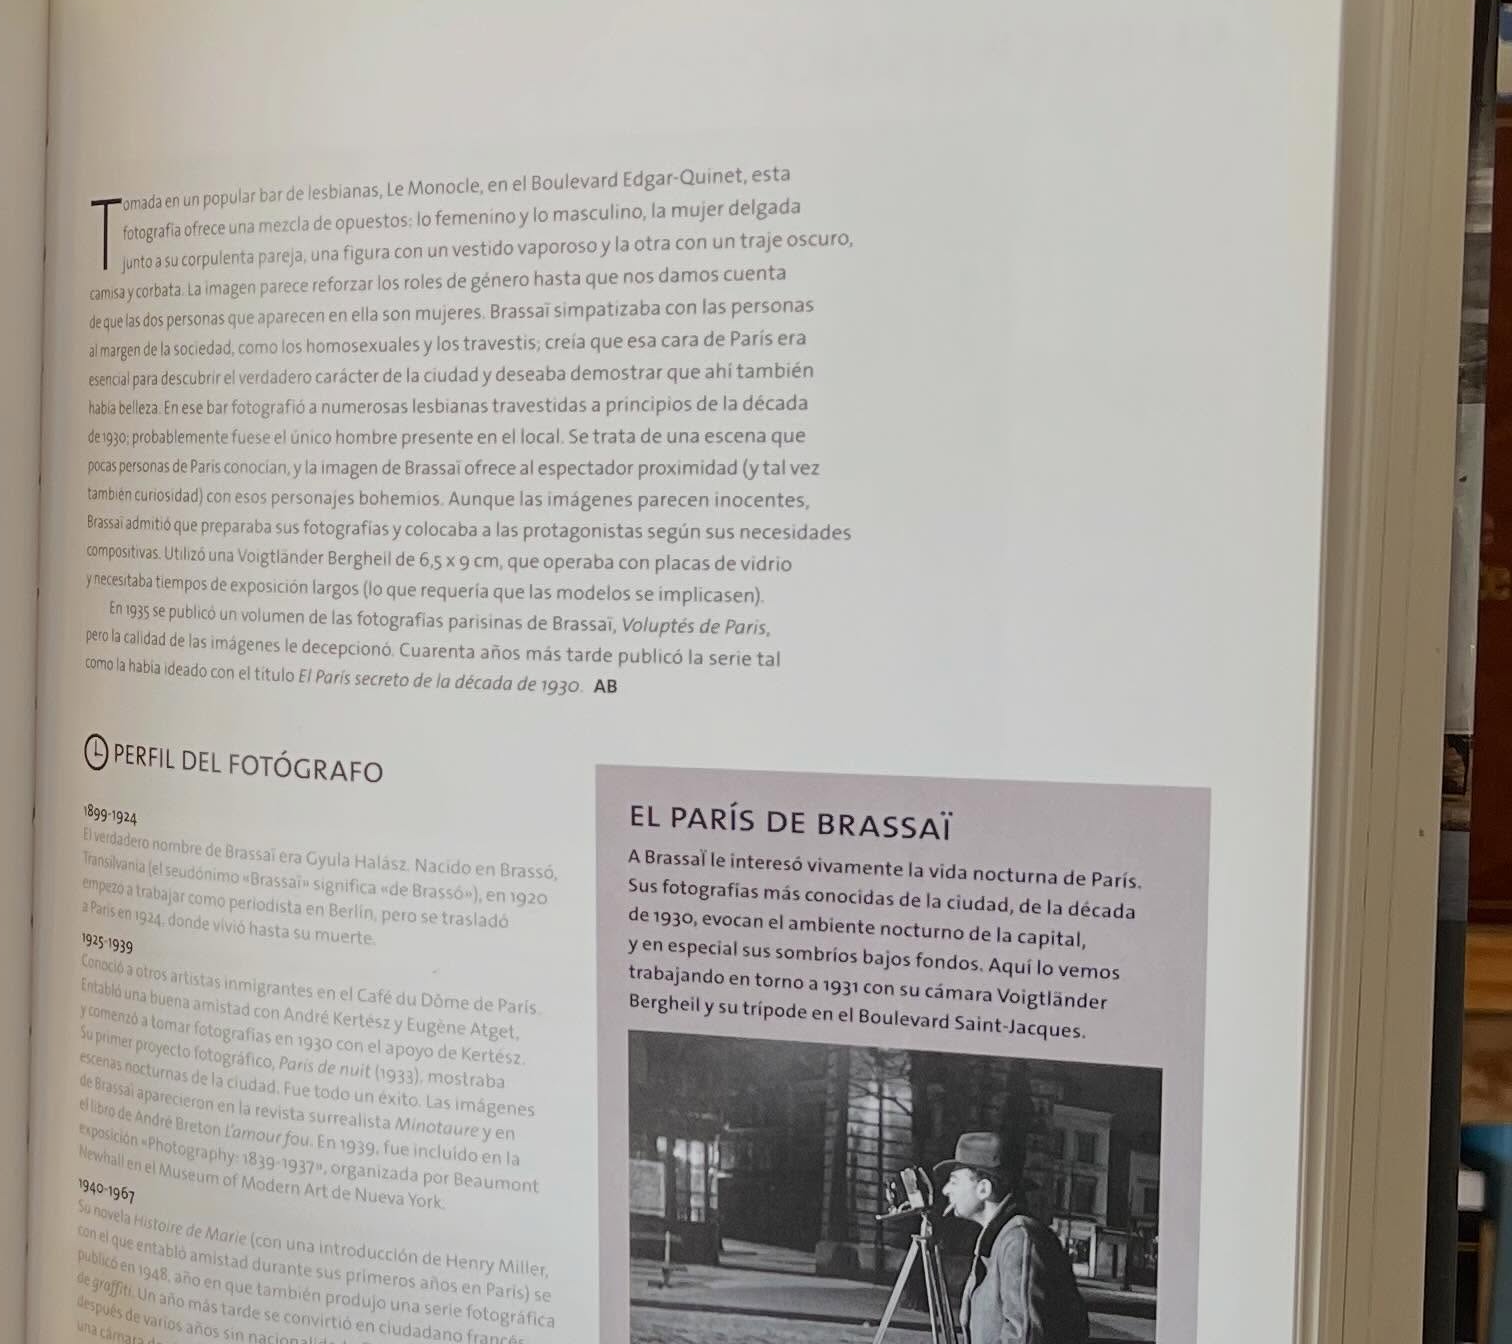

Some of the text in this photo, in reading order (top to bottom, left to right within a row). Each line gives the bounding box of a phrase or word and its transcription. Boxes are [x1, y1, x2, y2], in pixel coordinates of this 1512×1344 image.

[122, 196, 801, 246] fotografía ofrece una mezcla de opuestos: lo femenino y lo masculino, la mujer delgada
[541, 678, 619, 696] 1930. AB
[113, 741, 384, 784] PERFIL DEL FOTÓGRAFO
[83, 803, 138, 828] 1899-1924
[630, 801, 954, 841] EL PARÍS DE BRASSAÏ
[627, 848, 641, 864] A
[710, 851, 726, 868] le
[730, 852, 803, 872] interesó
[806, 857, 904, 877] vivamente
[908, 861, 924, 879] la
[928, 863, 968, 881] vida
[972, 867, 1058, 886] nocturna
[1063, 869, 1087, 887] de
[1091, 871, 1142, 889] París.
[628, 877, 1136, 920] Sus fotografías más conocidas de la ciudad, de la década
[81, 932, 134, 955] 1925-1939
[628, 905, 1086, 951] de 1930, evocan el ambiente nocturno de la capital,
[627, 938, 1120, 981] y en especial sus sombríos bajos fondos. Aquí lo vemos
[628, 964, 1109, 1011] trabajando en torno a 1931 con su cámara Voigtländer
[629, 992, 1086, 1042] Bergheil y su trípode en el Boulevard Saint-Jacques.
[78, 1177, 136, 1205] 1940-1967
[453, 1171, 539, 1193] Beaumont
